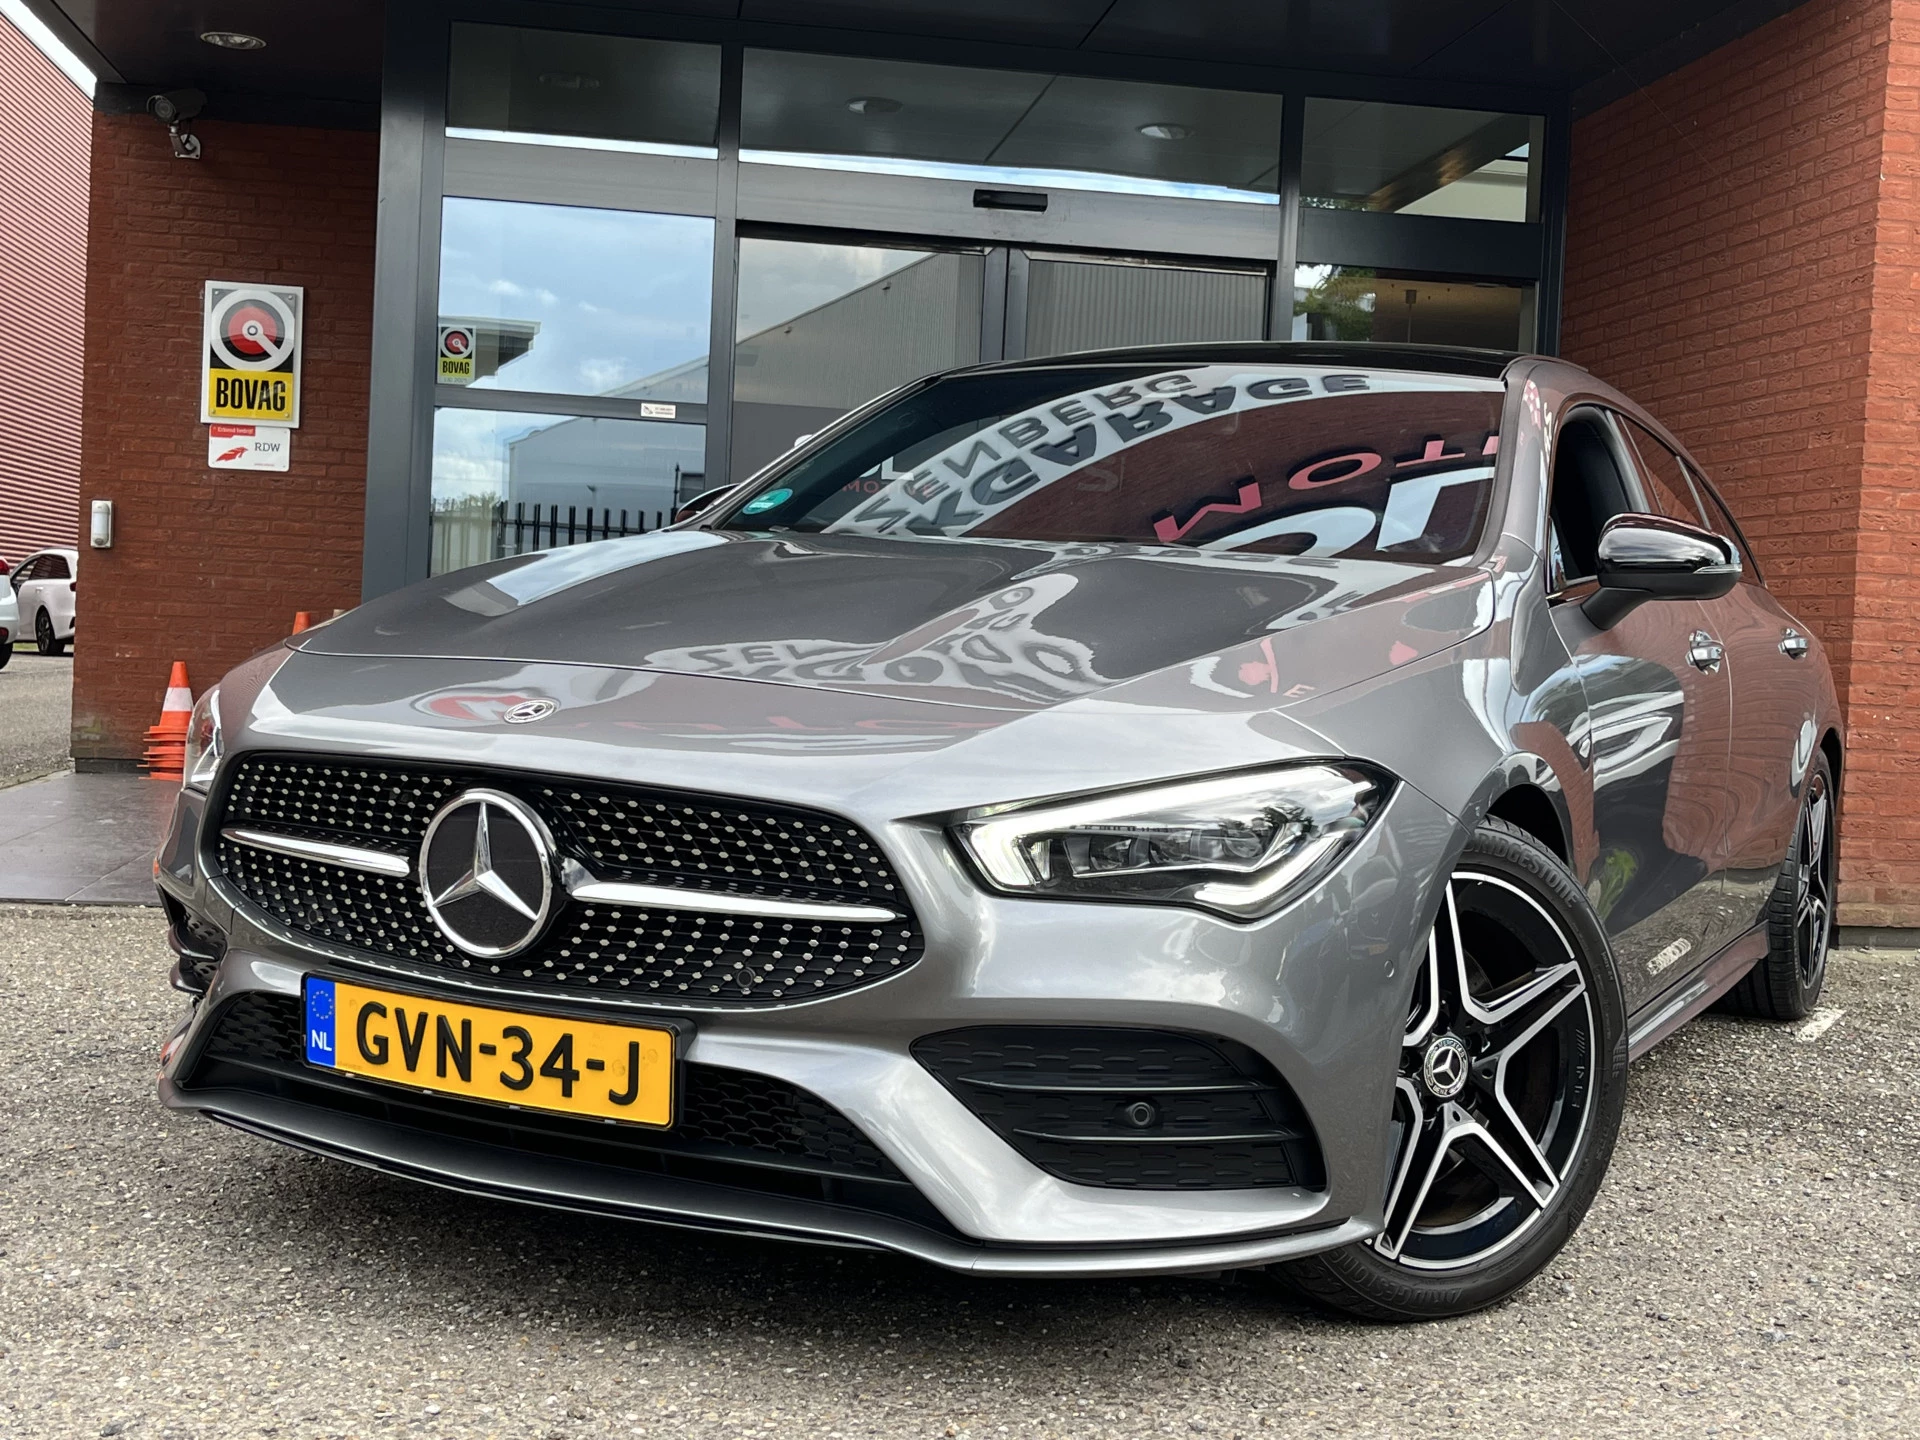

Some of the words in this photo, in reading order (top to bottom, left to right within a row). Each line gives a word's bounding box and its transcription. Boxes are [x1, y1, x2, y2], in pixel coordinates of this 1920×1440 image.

[442, 360, 470, 375] BOVAG
[215, 377, 286, 412] BOVAG
[254, 442, 281, 452] RDW
[311, 1029, 332, 1051] NL
[356, 1001, 640, 1106] GVN-34-J
